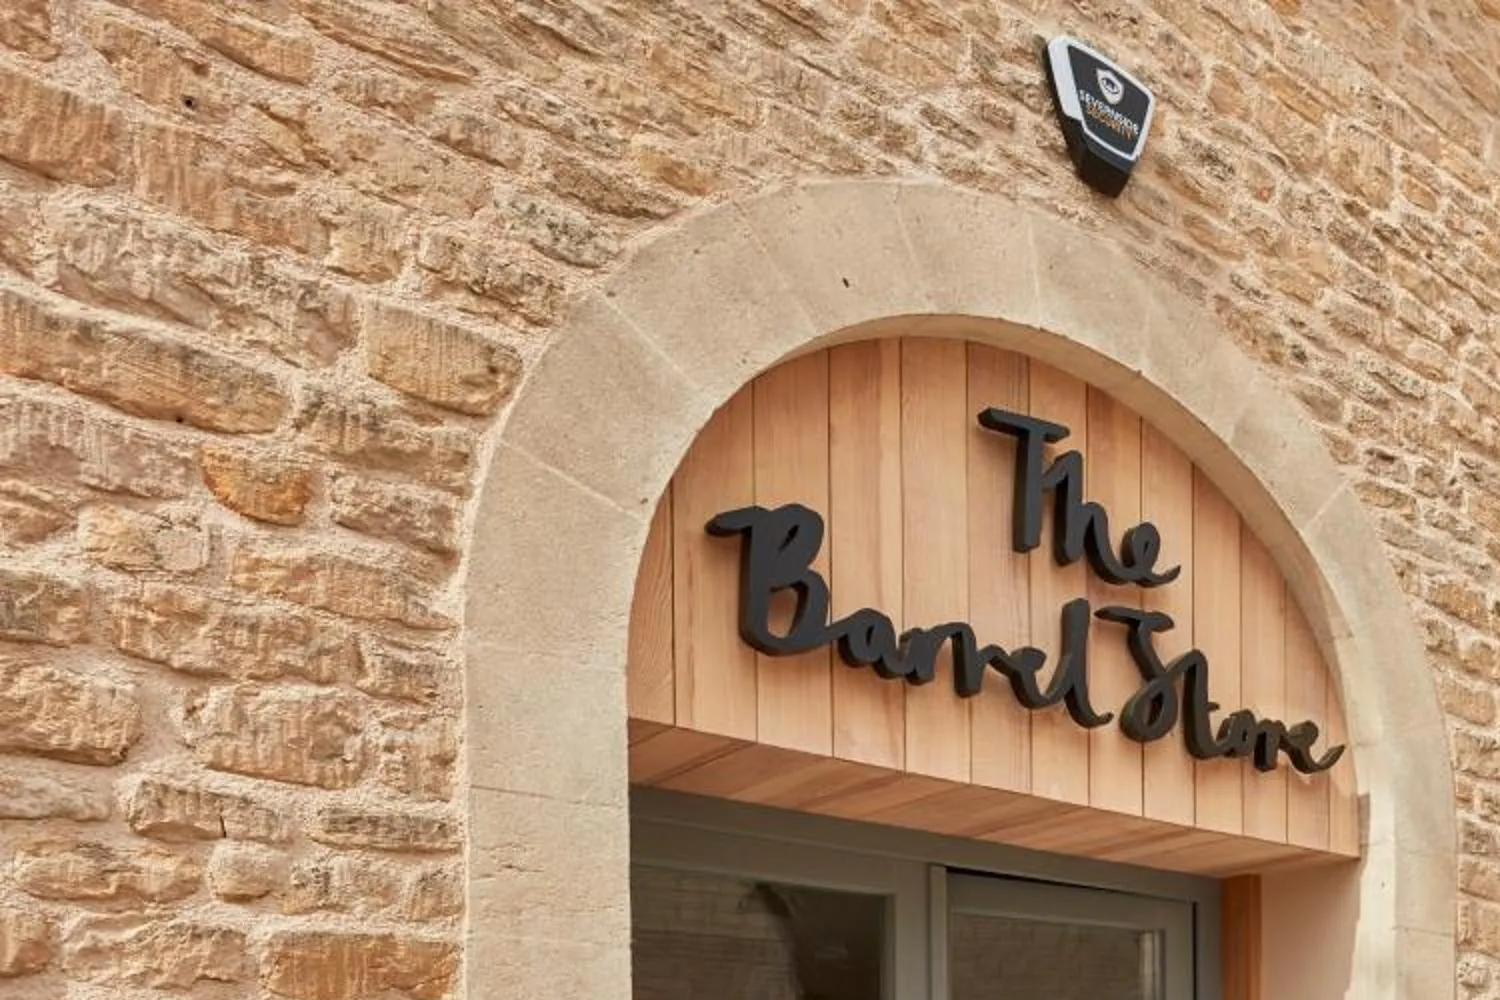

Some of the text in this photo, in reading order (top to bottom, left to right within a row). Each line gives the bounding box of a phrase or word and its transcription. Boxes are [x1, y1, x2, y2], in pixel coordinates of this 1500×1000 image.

[977, 406, 1181, 588] The
[704, 503, 1346, 773] Barrel Store
